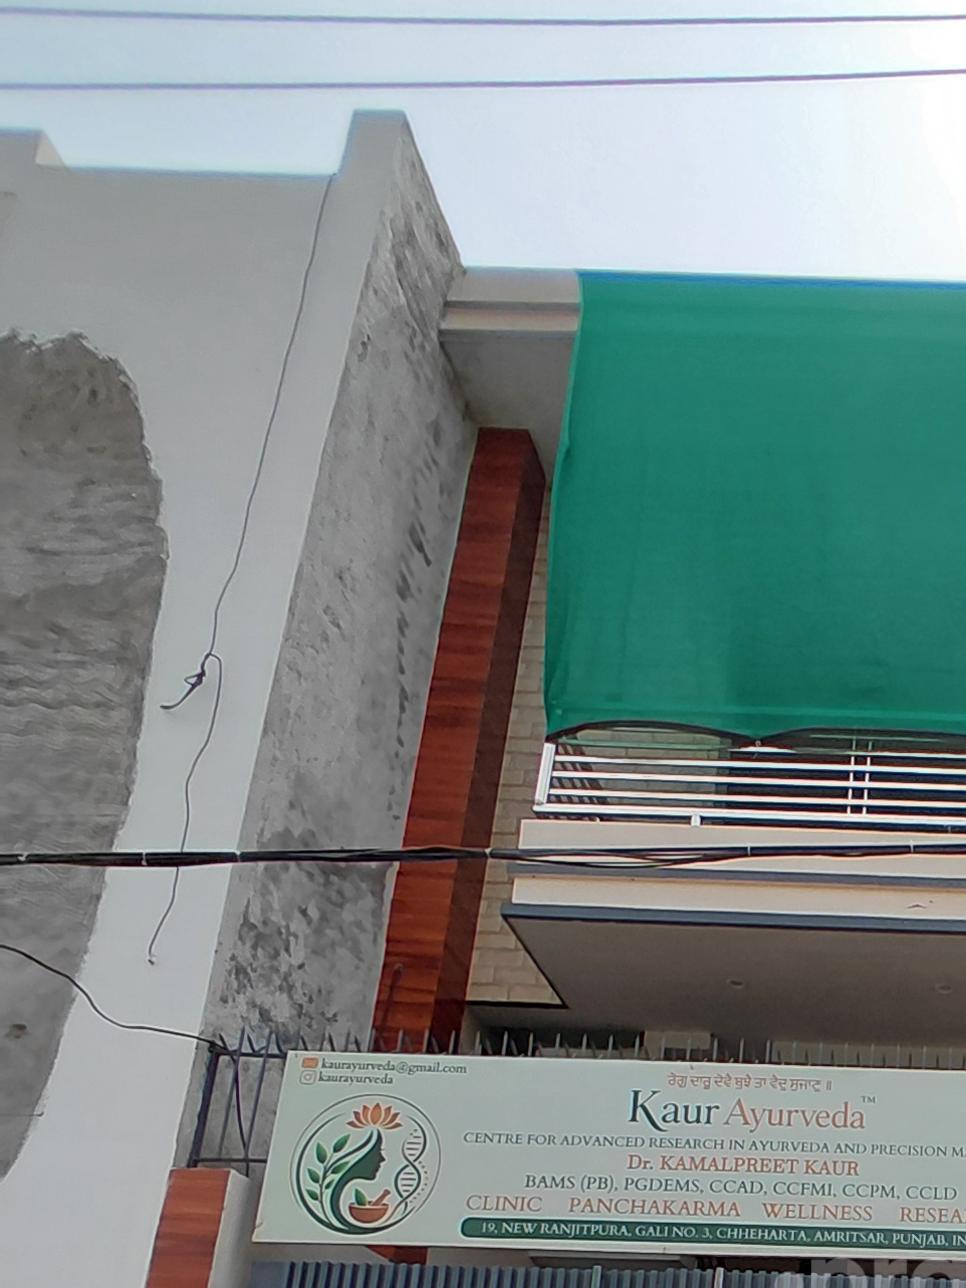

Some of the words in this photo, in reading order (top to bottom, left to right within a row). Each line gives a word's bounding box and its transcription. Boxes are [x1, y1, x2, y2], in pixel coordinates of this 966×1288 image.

[318, 1071, 393, 1085] kaurayurveda
[321, 1058, 467, 1075] kaurayurveda@gmail.com
[628, 1089, 720, 1132] Kaur
[723, 1097, 865, 1133] Ayurveda
[463, 1131, 523, 1145] CENTRE
[527, 1134, 557, 1146] FOR
[559, 1135, 645, 1148] ADVANCED
[649, 1136, 724, 1150] RESEARCH
[728, 1139, 745, 1150] IN
[749, 1140, 830, 1153] AYURVEDA
[832, 1143, 867, 1155] AND
[871, 1144, 947, 1157] PRECISION
[627, 1154, 653, 1170] Dr.
[659, 1155, 799, 1174] KAMALPREET
[803, 1159, 859, 1176] KAUR
[525, 1174, 575, 1189] BAMS
[580, 1174, 618, 1193] (PB),
[624, 1177, 704, 1194] PGDEMS,
[709, 1179, 767, 1196] CCAD,
[773, 1181, 837, 1198] CCFMI,
[842, 1183, 900, 1200] CCPM,
[906, 1185, 957, 1200] CCLD
[466, 1195, 543, 1212] CLINIC
[569, 1197, 741, 1217] PANCHAKARMA
[763, 1202, 873, 1222] WELLNESS
[501, 1222, 538, 1234] NEW
[635, 1225, 668, 1237] GALI
[671, 1226, 698, 1238] NO.
